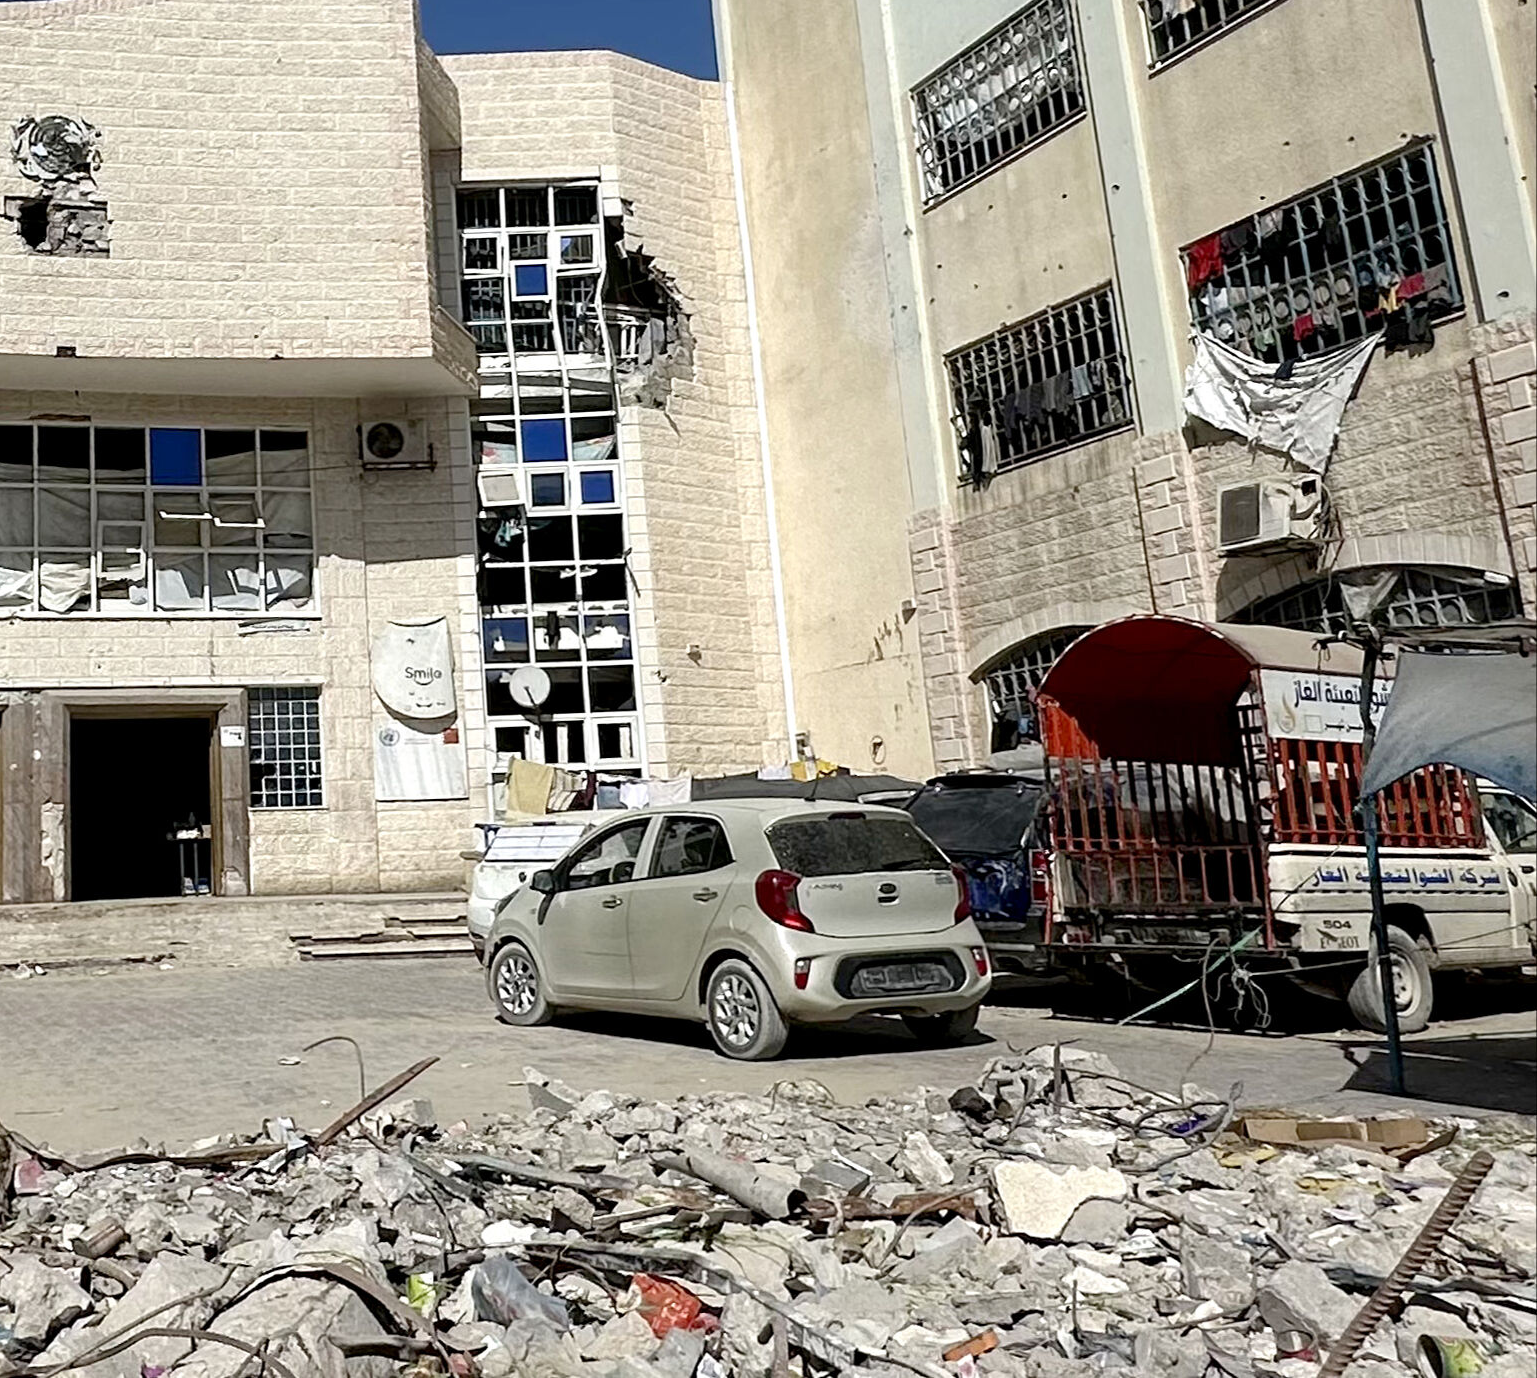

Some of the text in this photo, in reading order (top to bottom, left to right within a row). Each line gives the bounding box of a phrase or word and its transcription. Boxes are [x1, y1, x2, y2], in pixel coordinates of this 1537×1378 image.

[404, 666, 442, 680] Smile
[1459, 866, 1501, 888] شركة
[1323, 919, 1352, 930] 504
